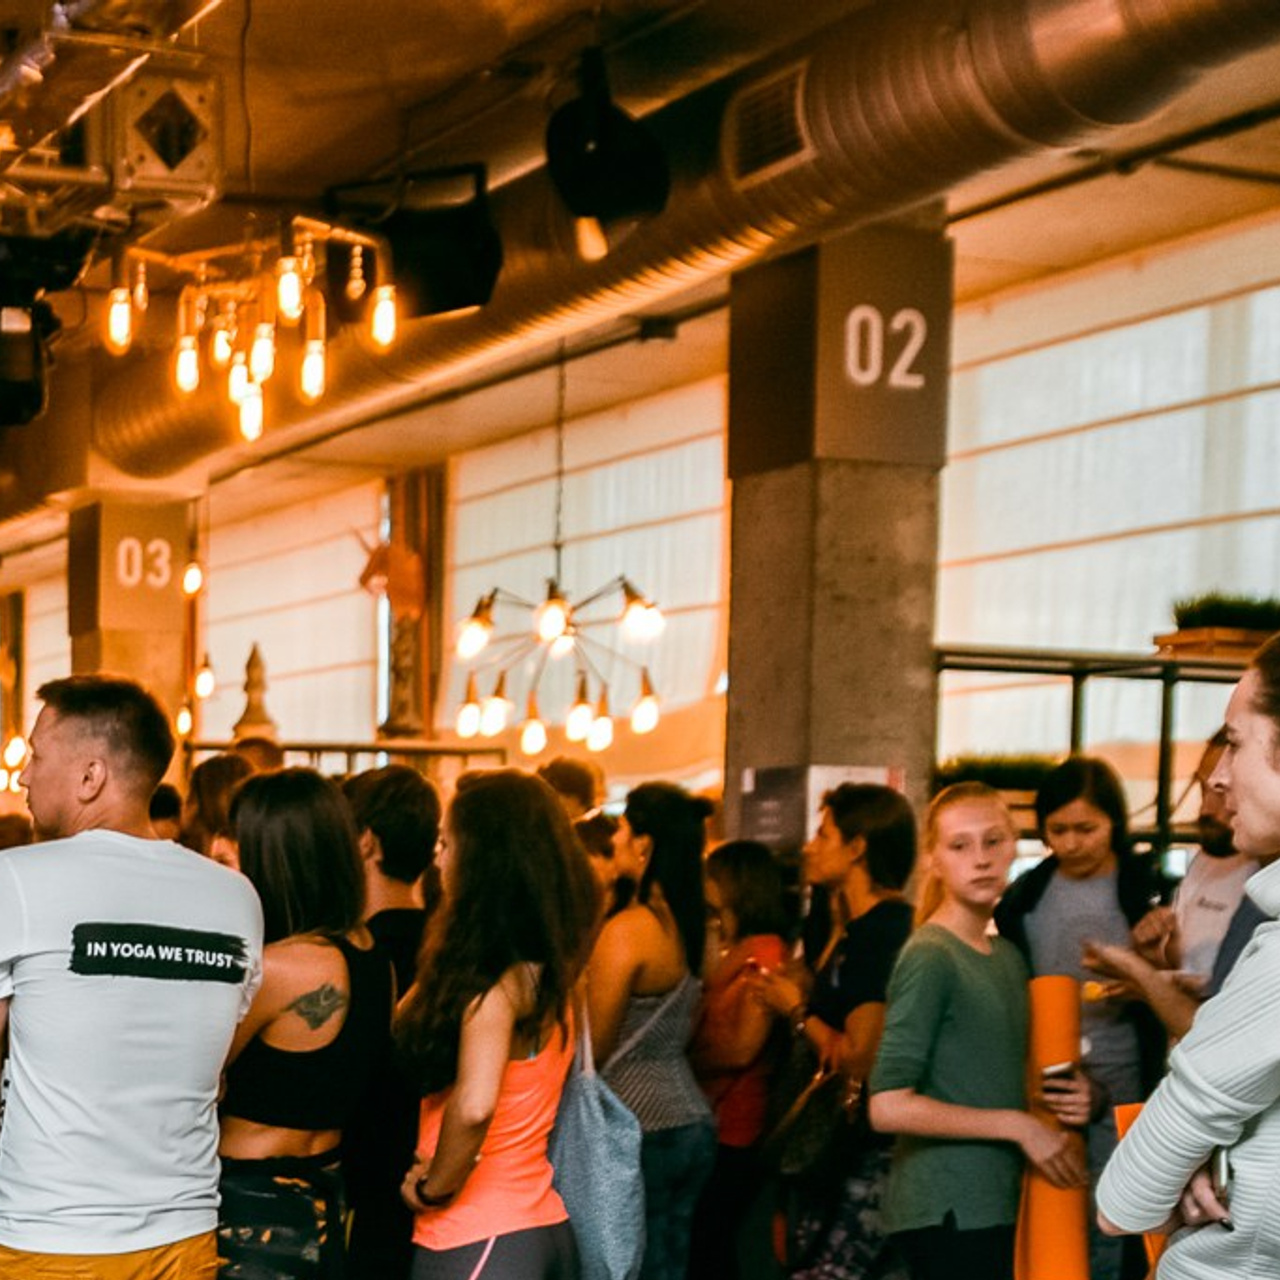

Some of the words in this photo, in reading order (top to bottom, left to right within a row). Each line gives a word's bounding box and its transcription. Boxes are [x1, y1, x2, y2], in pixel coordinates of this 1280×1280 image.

[845, 304, 927, 388] 02
[117, 536, 171, 589] 03
[87, 942, 107, 957] IN
[110, 942, 157, 960] YOGA
[158, 945, 183, 962] WE
[185, 948, 234, 968] TRUST
